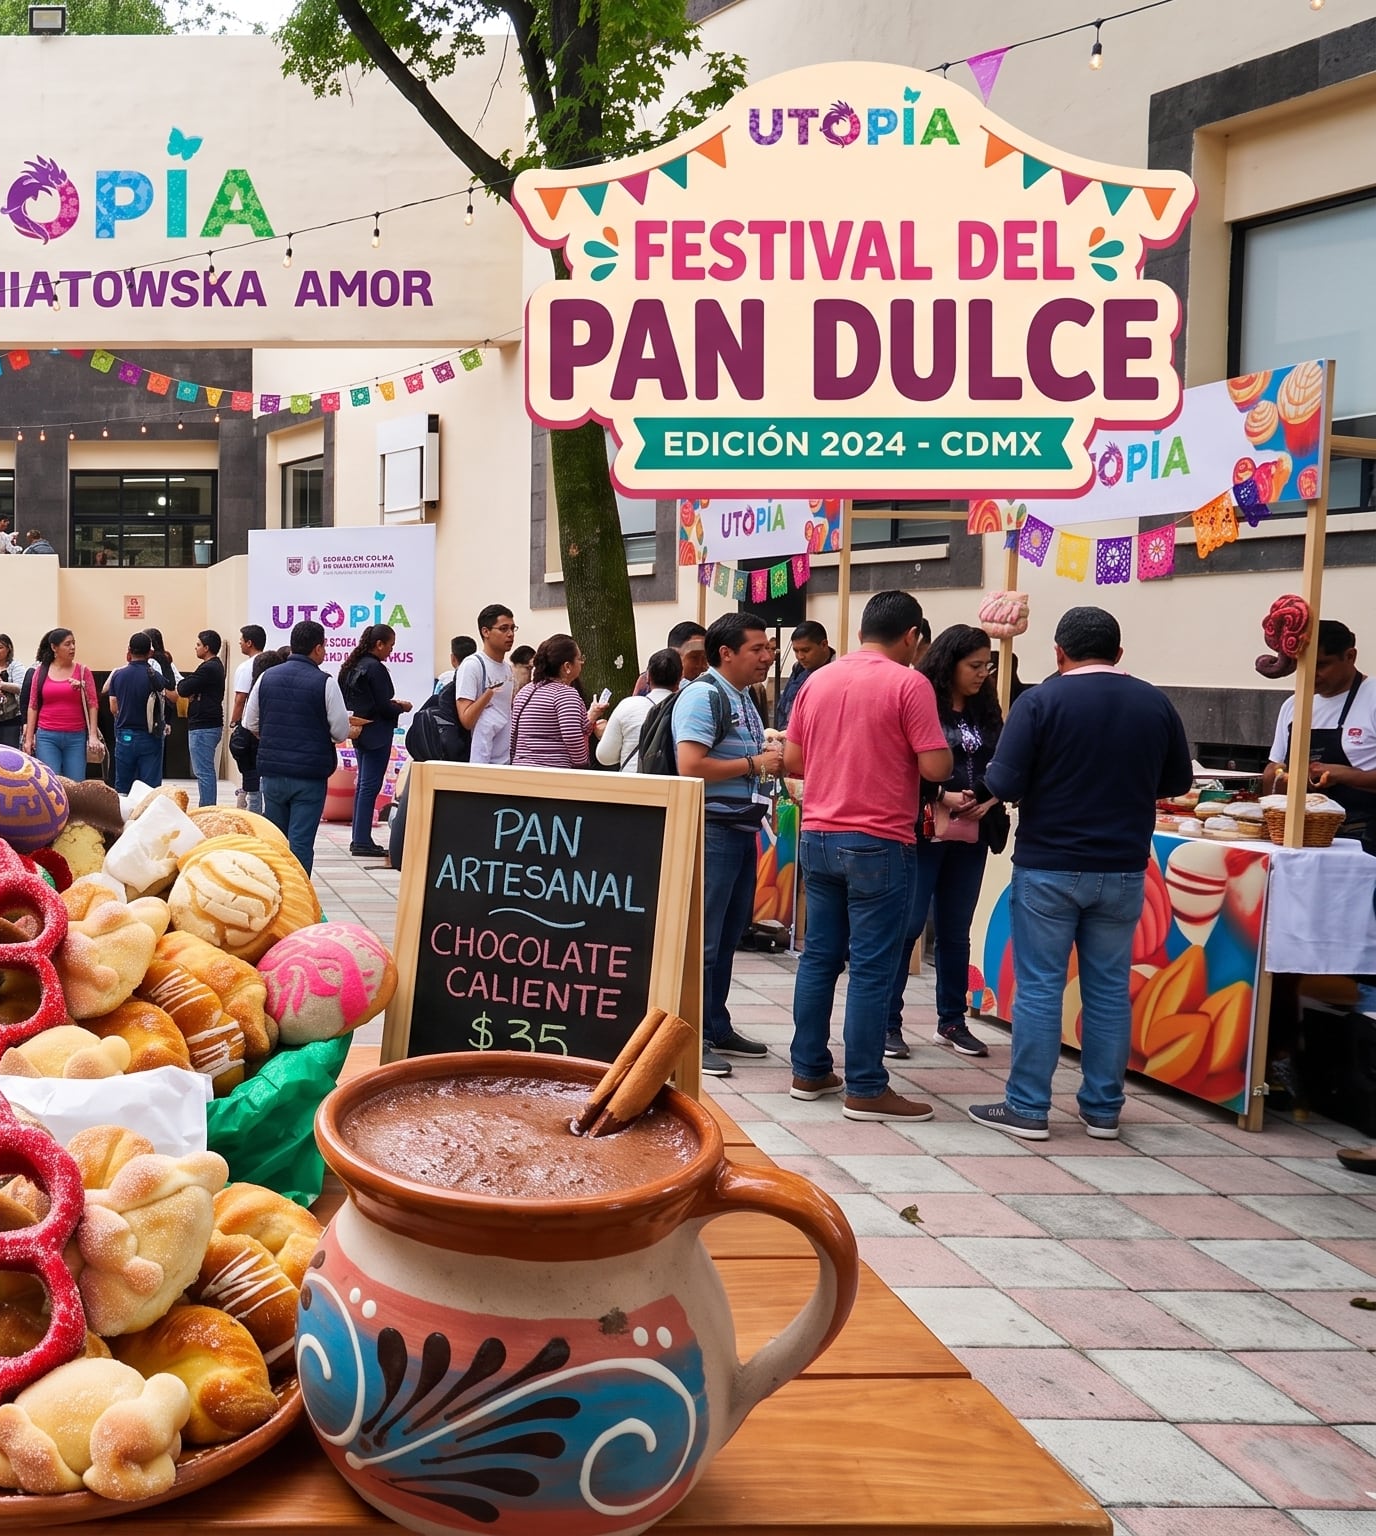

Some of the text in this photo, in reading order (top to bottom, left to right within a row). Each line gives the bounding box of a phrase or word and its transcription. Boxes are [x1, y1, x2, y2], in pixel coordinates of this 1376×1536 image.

[294, 270, 433, 307] AMOR
[493, 808, 583, 858] PAN
[435, 854, 645, 913] ARTESANAL
[431, 922, 632, 978] CHOCOLATE
[446, 966, 621, 1019] CALIENTE
